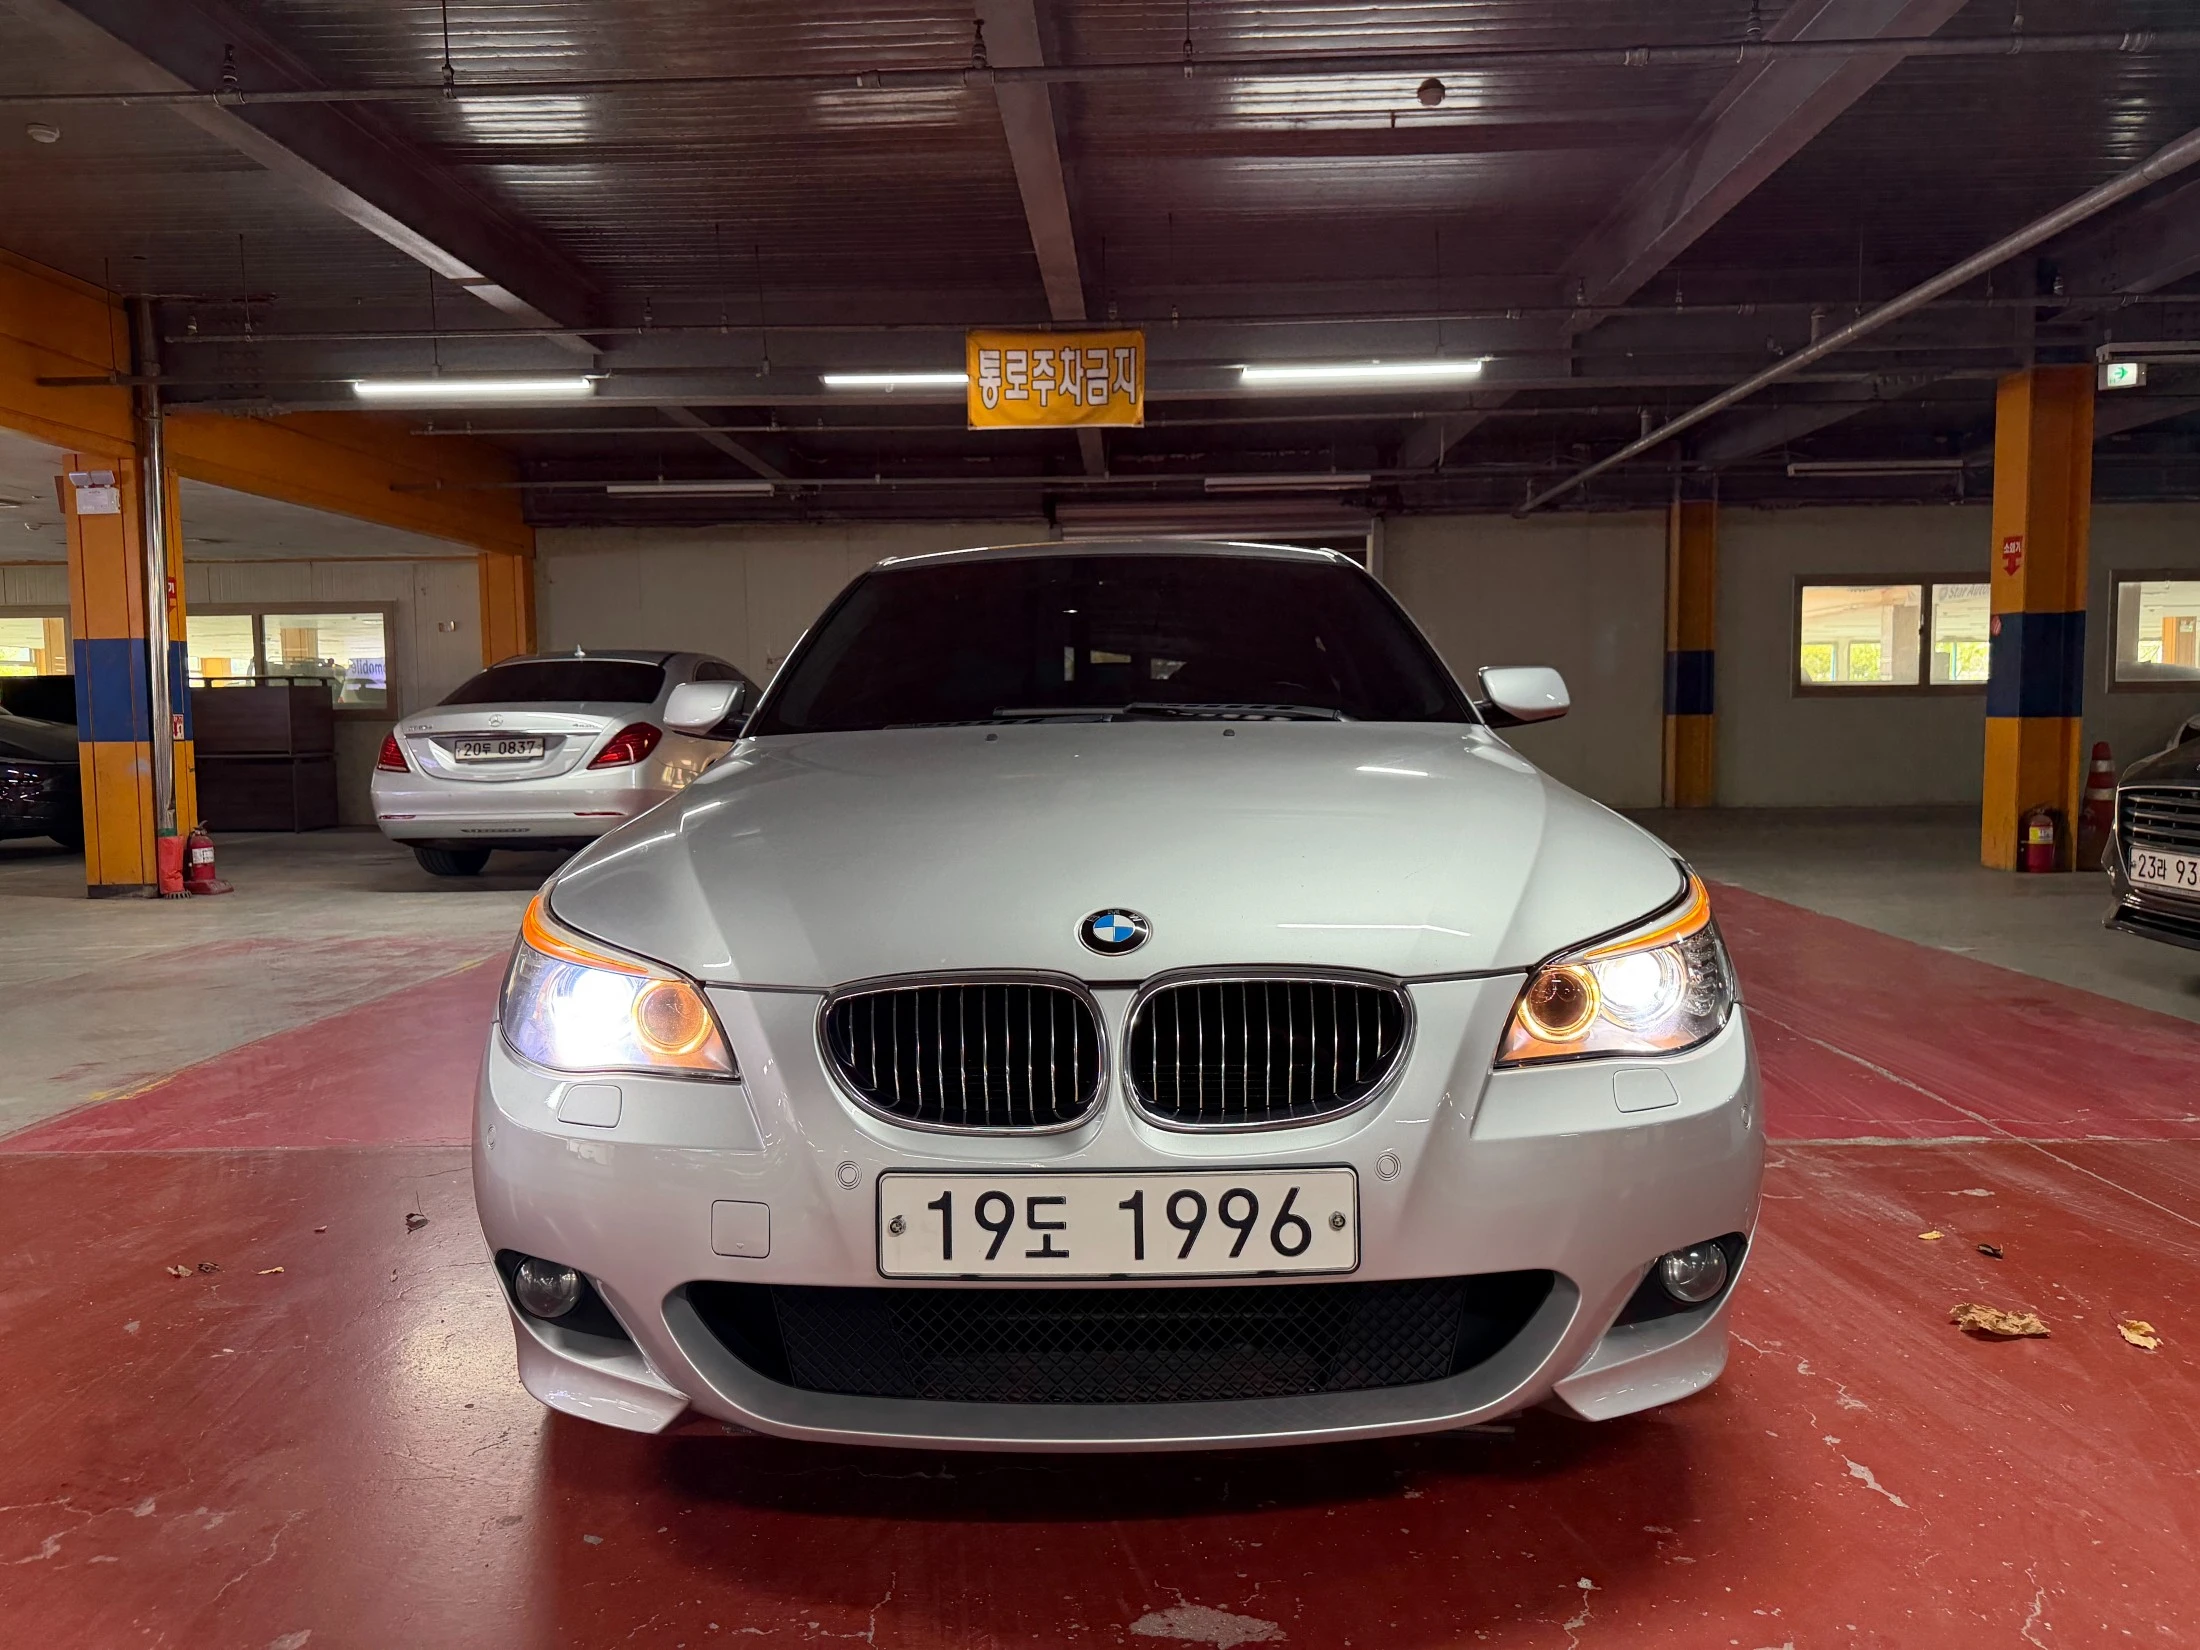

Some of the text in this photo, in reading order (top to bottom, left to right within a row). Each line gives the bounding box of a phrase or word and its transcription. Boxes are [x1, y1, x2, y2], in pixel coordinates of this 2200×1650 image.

[978, 346, 1137, 410] 통로주차금지
[498, 740, 536, 755] 0837
[2138, 853, 2167, 880] 23라
[927, 1186, 1312, 1261] 19도 1996
